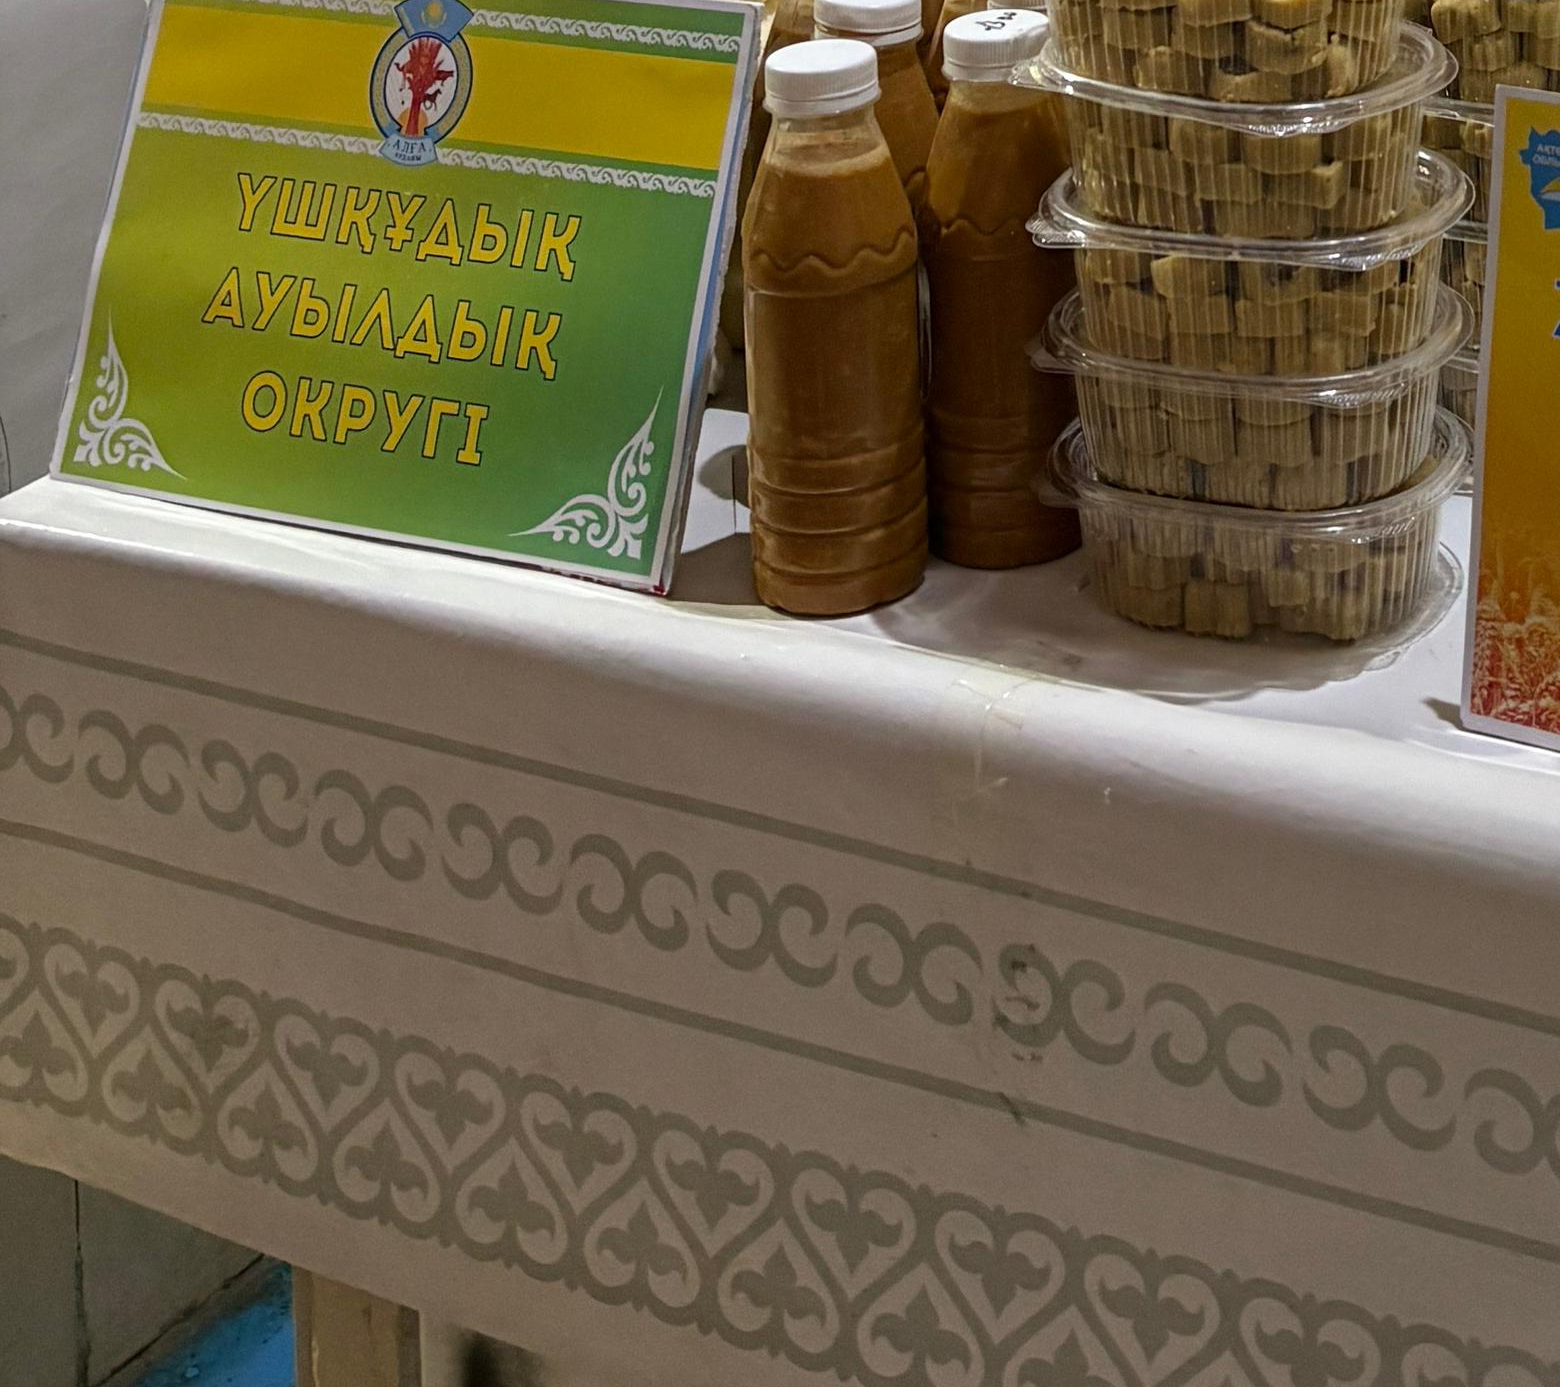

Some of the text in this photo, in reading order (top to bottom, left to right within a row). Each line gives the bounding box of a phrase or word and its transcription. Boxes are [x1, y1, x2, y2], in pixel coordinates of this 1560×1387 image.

[237, 172, 582, 281] ҮШҚҰДЫҚ
[202, 267, 562, 380] АУЫЛДЫҚ
[241, 370, 489, 466] ОКРУГІ
